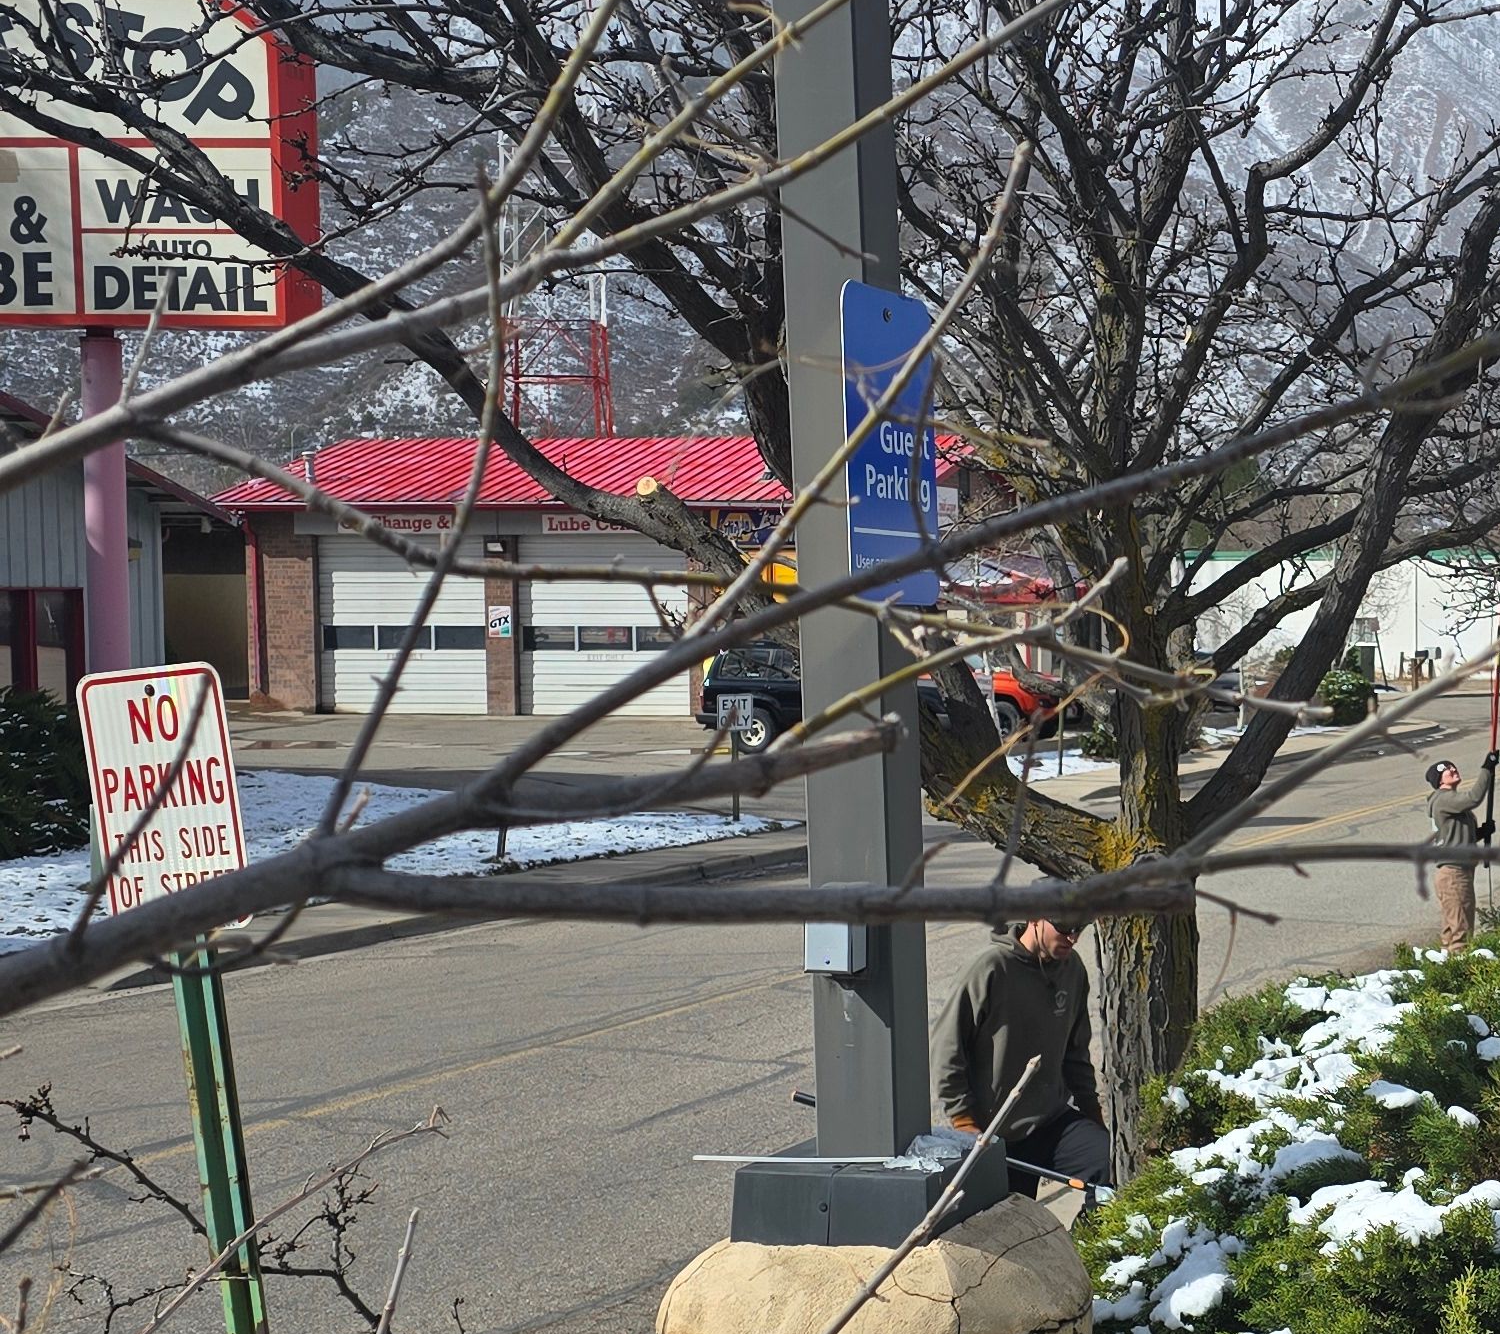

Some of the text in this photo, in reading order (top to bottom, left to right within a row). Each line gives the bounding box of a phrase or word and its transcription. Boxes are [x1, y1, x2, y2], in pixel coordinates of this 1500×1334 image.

[10, 195, 48, 244] &
[147, 240, 212, 261] AUTO
[94, 266, 268, 312] DETAIL
[547, 516, 590, 531] Lube
[490, 614, 510, 629] GTX
[127, 694, 179, 745] NO
[722, 698, 748, 711] EXIT
[102, 756, 225, 814] PARKING
[178, 825, 230, 859] SIDE
[119, 876, 144, 909] OF
